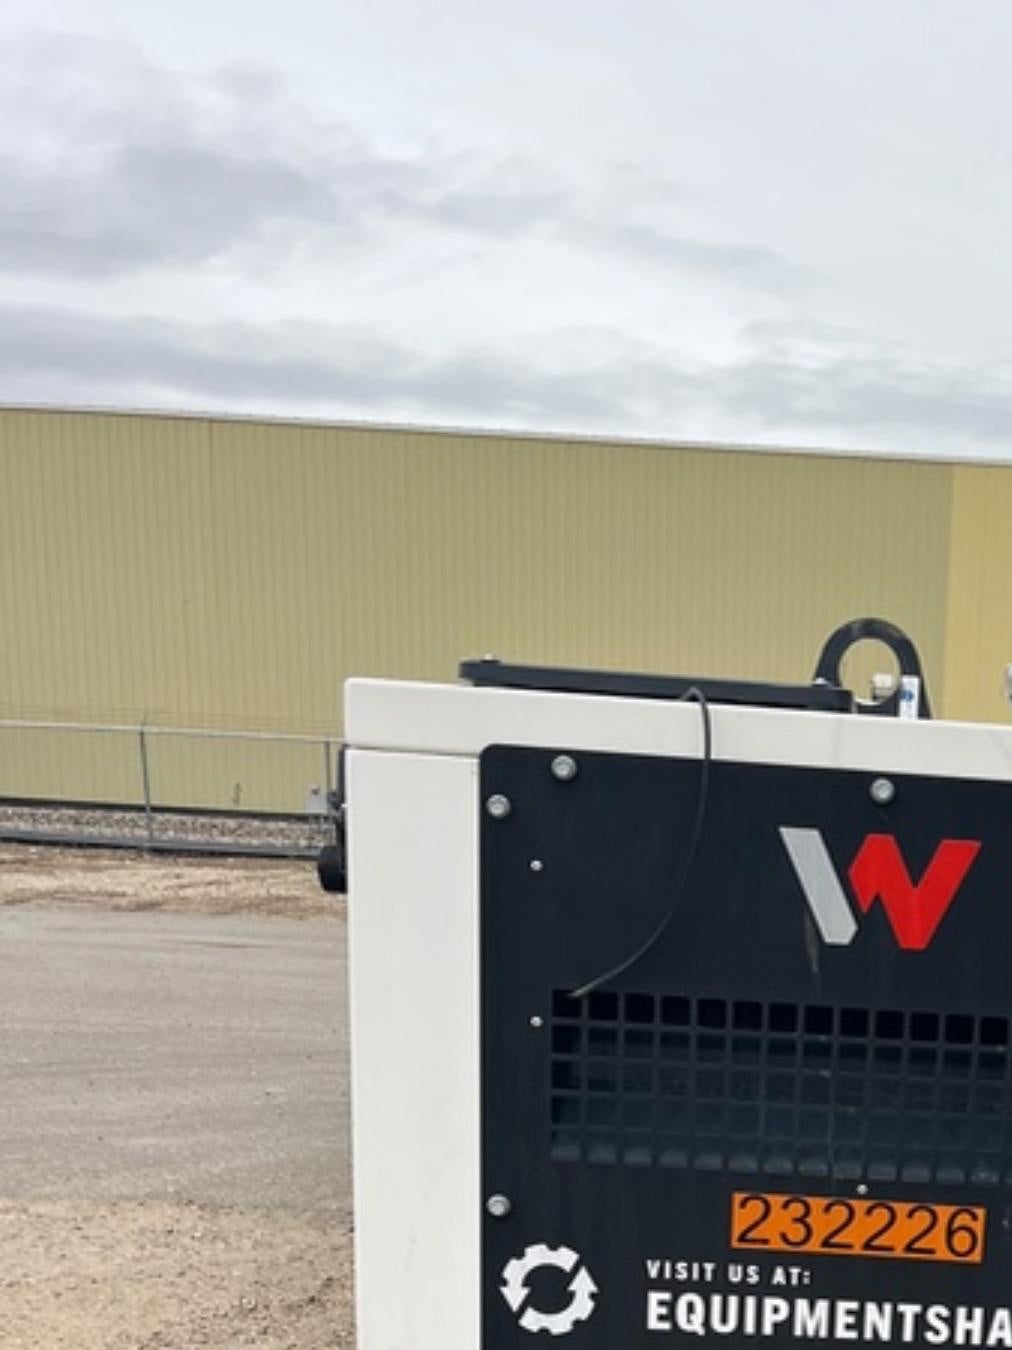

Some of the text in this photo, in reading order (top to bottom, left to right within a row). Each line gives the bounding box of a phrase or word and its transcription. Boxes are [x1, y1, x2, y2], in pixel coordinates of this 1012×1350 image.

[737, 1196, 979, 1258] 232226
[647, 1259, 811, 1286] VISIT US AT:
